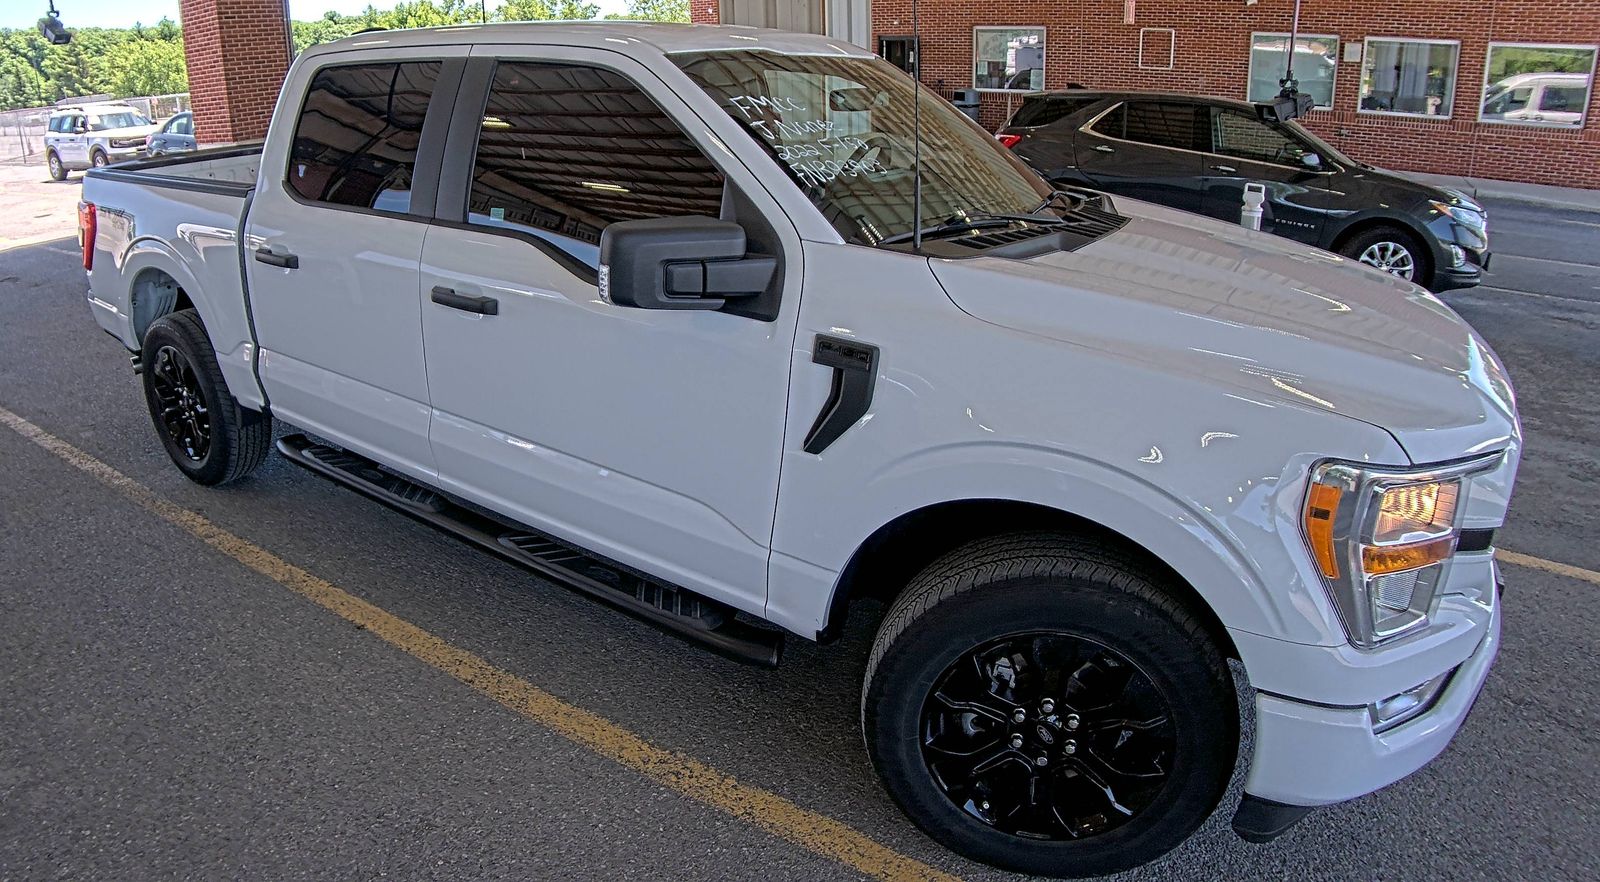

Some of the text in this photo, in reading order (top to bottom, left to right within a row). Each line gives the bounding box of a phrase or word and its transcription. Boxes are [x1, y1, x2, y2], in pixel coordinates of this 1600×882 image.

[729, 95, 806, 118] FMCC
[774, 136, 869, 160] 2022 F-150
